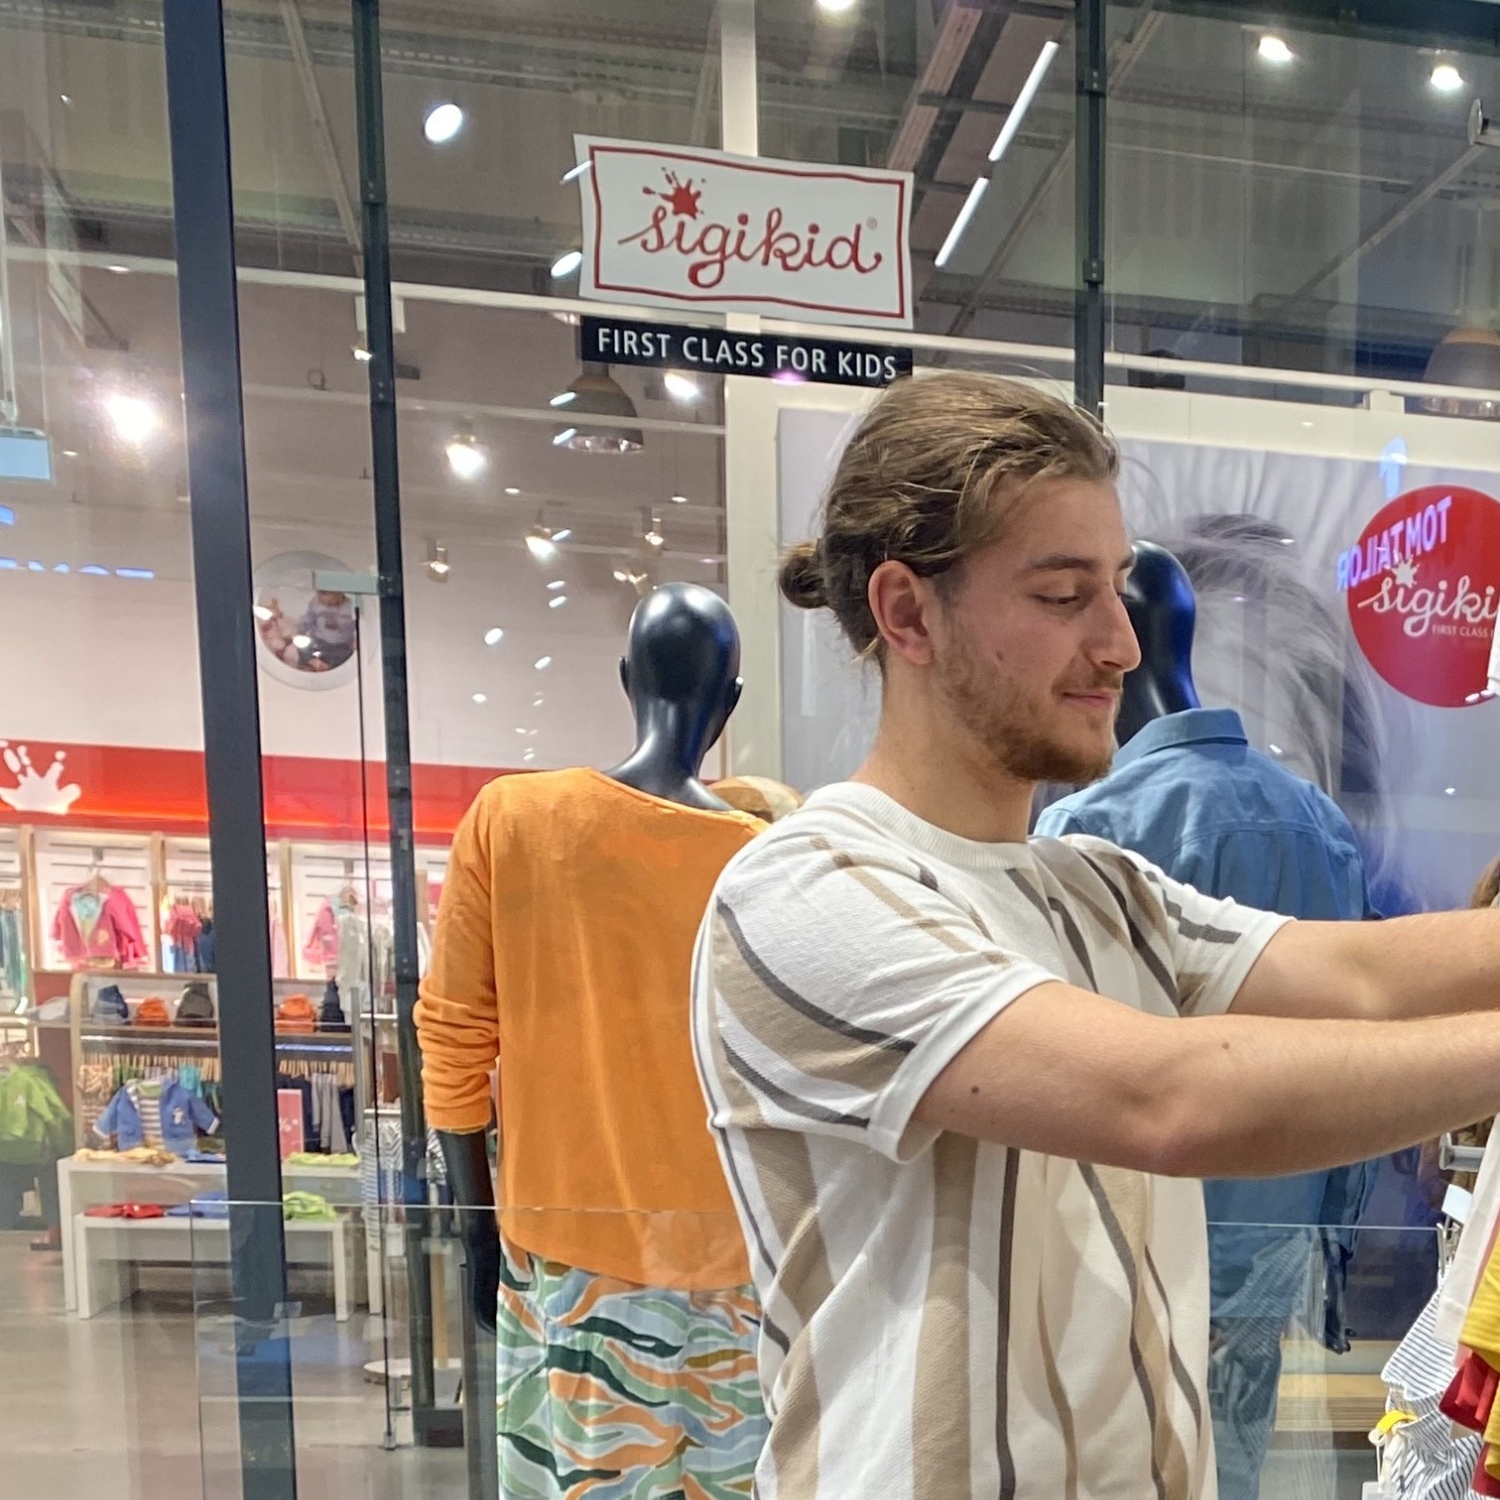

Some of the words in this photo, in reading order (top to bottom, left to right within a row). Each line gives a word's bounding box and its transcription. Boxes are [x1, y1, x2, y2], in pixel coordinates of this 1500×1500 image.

[618, 205, 882, 289] sigikid
[597, 327, 671, 359] FIRST
[682, 336, 765, 368] CLASS
[775, 344, 827, 374] FOR
[837, 351, 897, 380] KIDS
[1357, 575, 1499, 637] sigiki
[1432, 624, 1456, 636] FIRST
[1459, 625, 1488, 638] CLASS
